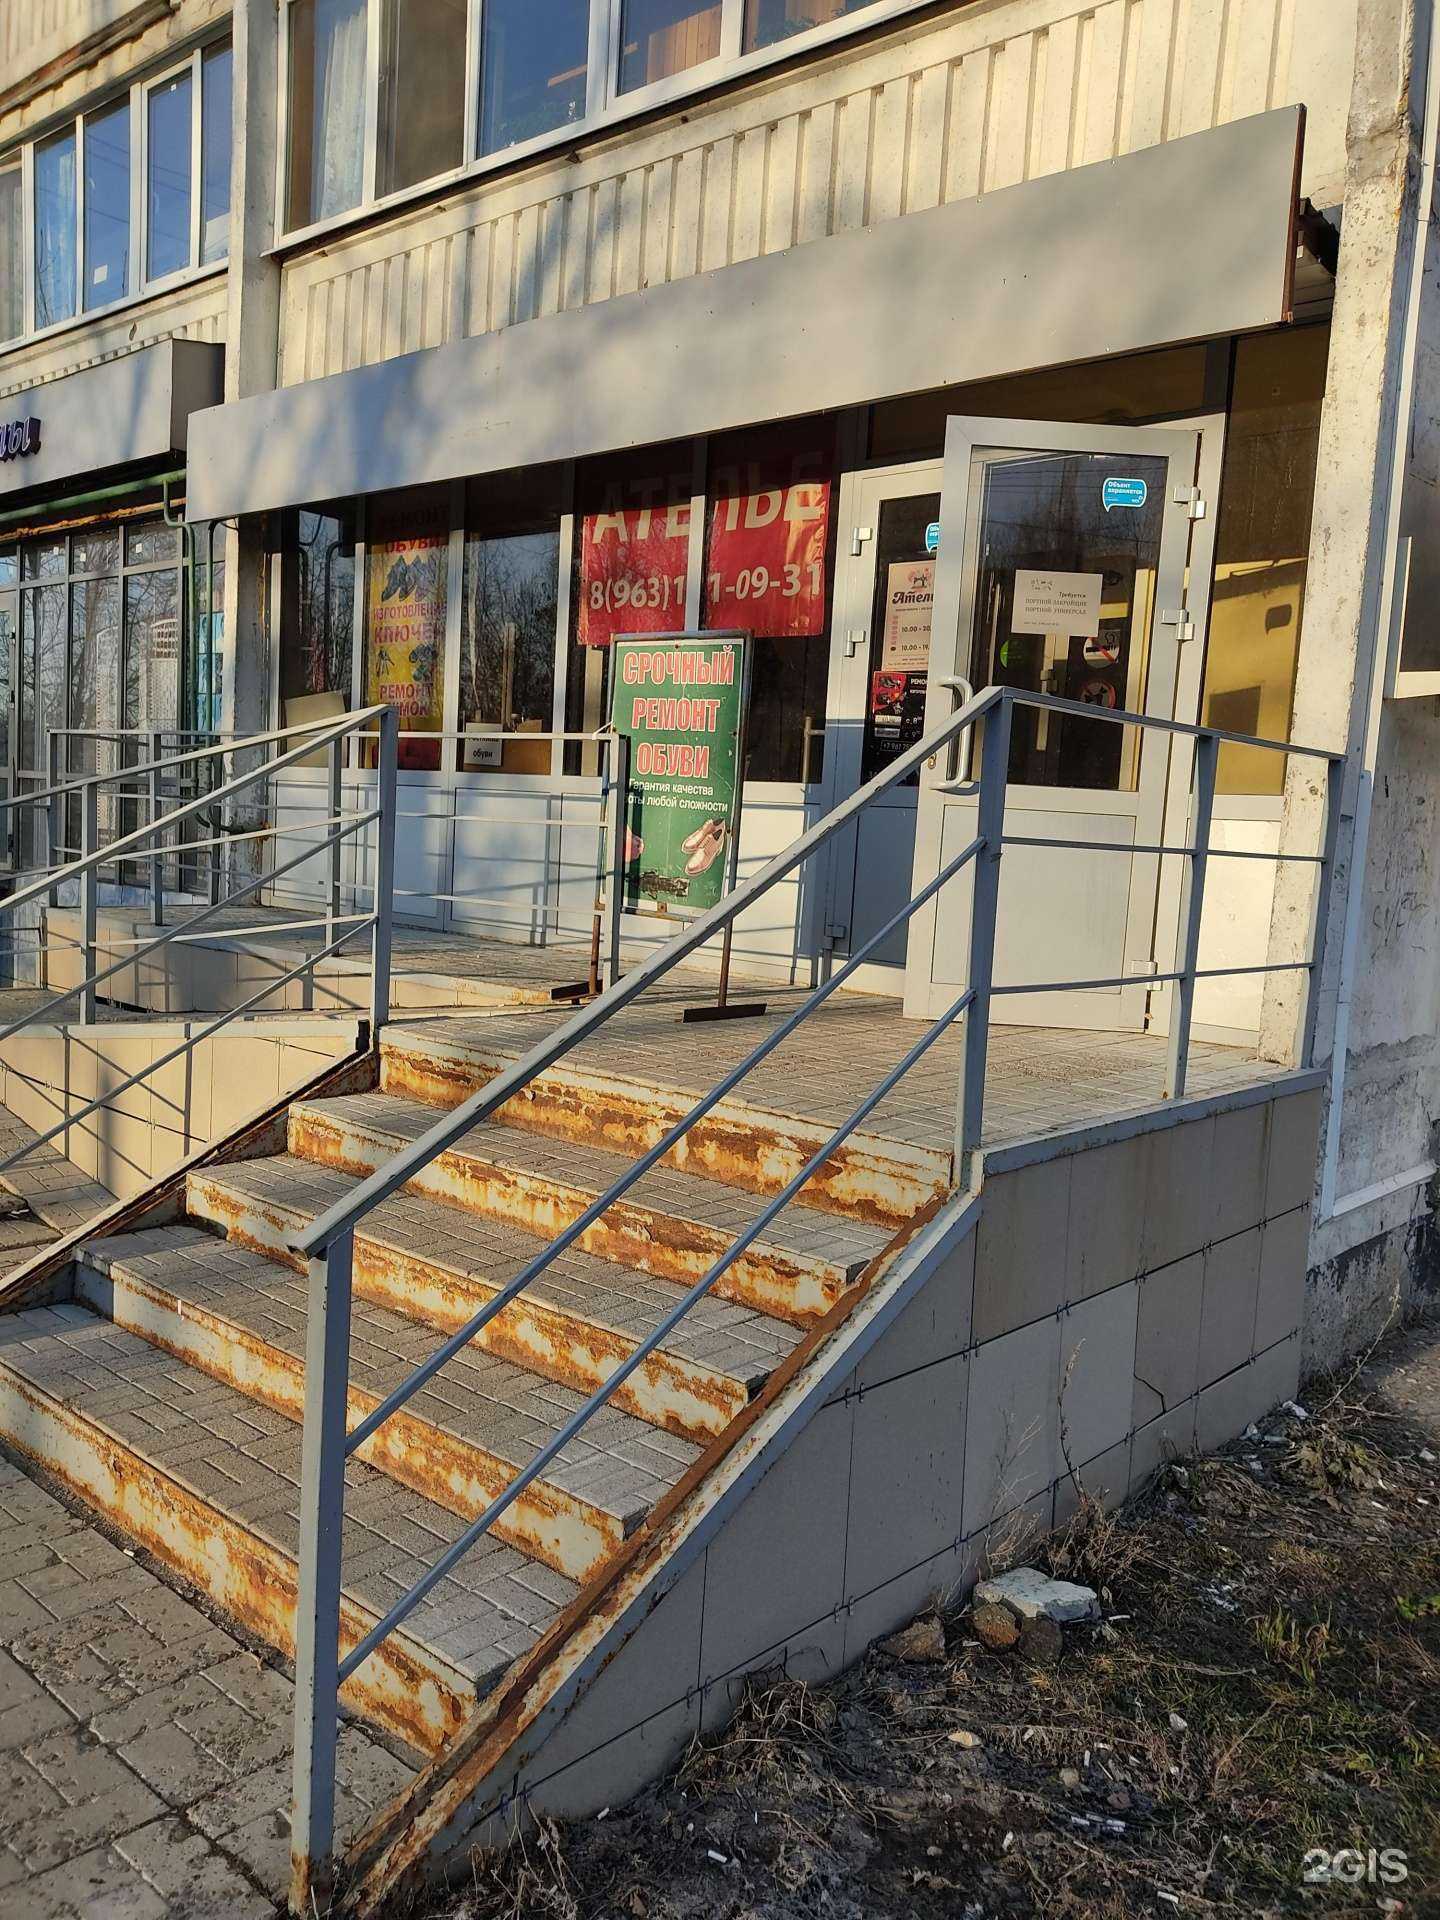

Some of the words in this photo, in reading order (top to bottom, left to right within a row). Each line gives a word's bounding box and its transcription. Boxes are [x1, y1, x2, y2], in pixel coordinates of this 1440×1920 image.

[590, 563, 821, 613] 8(963)11-09-31
[892, 591, 934, 605] Ател
[623, 645, 735, 686] СРОЧНЫЙ
[379, 682, 434, 699] РЕМОНТ
[632, 697, 721, 732] РЕМОНТ
[636, 742, 710, 779] ОБУВИ
[629, 778, 670, 793] Гарантия
[672, 783, 714, 796] качества
[646, 795, 678, 809] любой
[679, 798, 728, 812] сложности
